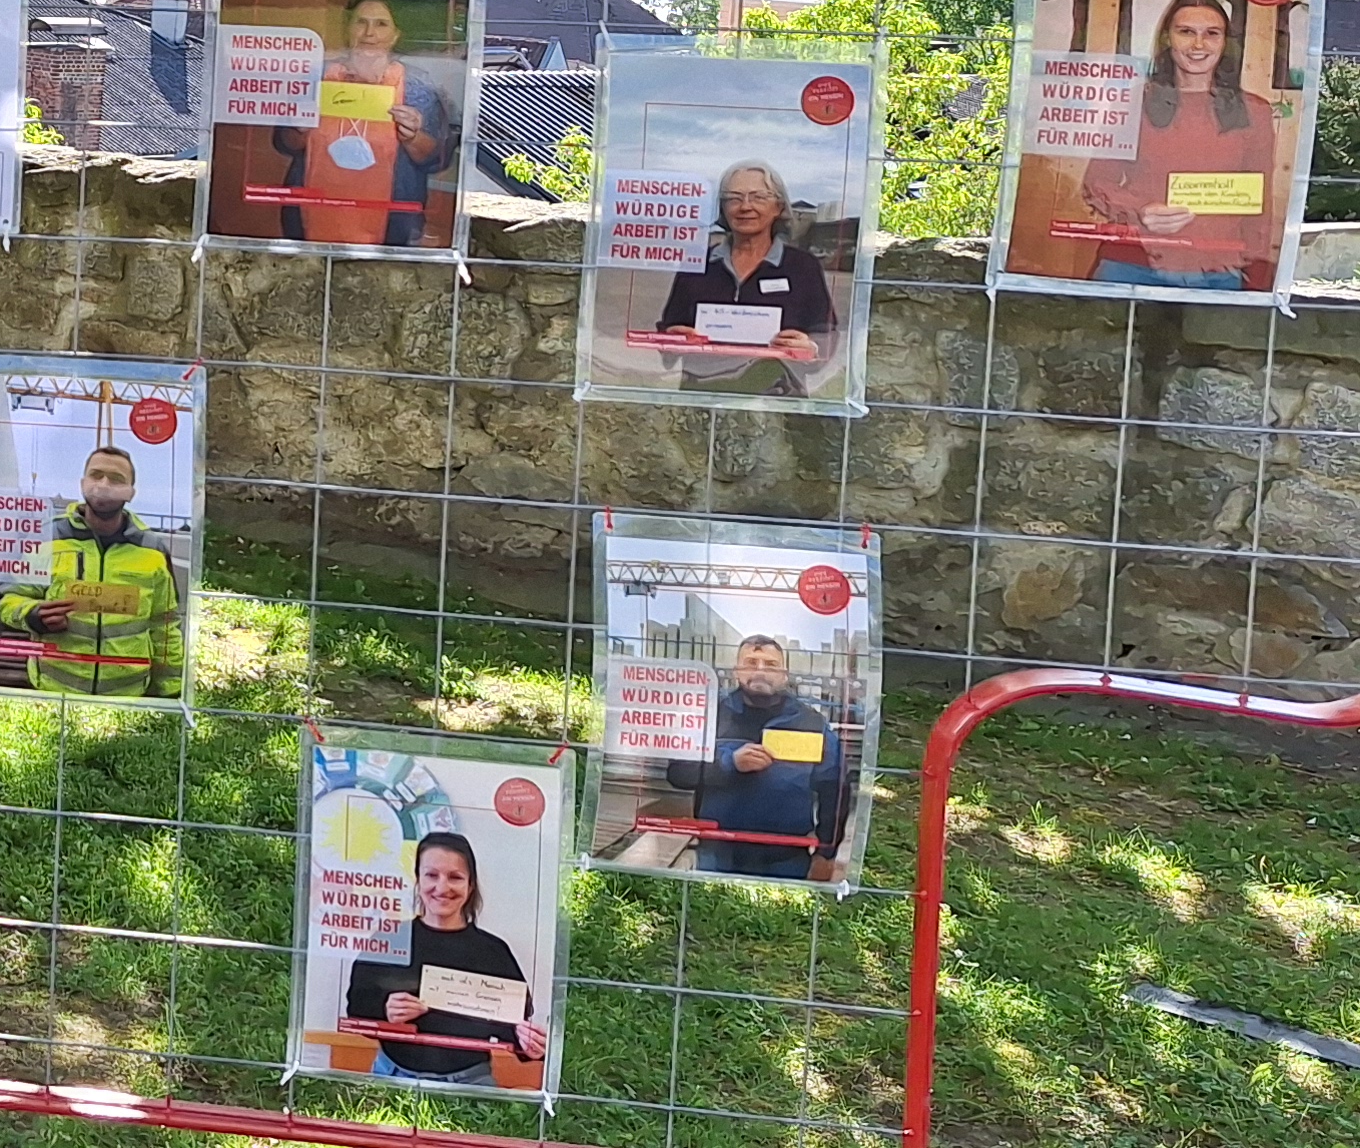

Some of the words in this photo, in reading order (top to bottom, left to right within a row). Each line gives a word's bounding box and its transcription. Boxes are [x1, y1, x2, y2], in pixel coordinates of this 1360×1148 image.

[232, 35, 317, 51] MENSCHEN-
[231, 56, 310, 73] WÜRDIGE
[1045, 61, 1138, 78] MENSCHEN-
[229, 79, 281, 94] ARBEIT
[287, 81, 310, 95] IST
[1042, 82, 1131, 102] WÜRDIGE
[228, 98, 255, 114] FÜR
[260, 101, 297, 116] MICH
[1039, 107, 1097, 123] ARBEIT
[1103, 110, 1128, 125] IST
[1037, 129, 1068, 145] FÜR
[1073, 133, 1114, 148] MICH
[617, 179, 706, 196] MENSCHEN-
[615, 199, 699, 219] WÜRDIGE
[613, 224, 667, 239] ARBEIT
[673, 226, 698, 240] IST
[611, 242, 640, 259] FÜR
[645, 246, 683, 261] MICH
[20, 539, 42, 553] IST
[623, 665, 710, 684] MENSCHEN-
[622, 686, 706, 707] WÜRDIGE
[621, 710, 675, 726] ARBEIT
[681, 713, 706, 729] IST
[620, 730, 648, 747] FÜR
[653, 733, 691, 749] MICH
[323, 870, 407, 891] MENSCHEN-
[322, 890, 401, 911] WÜRDIGE
[321, 912, 373, 930] ARBEIT
[378, 917, 401, 932] IST
[321, 933, 348, 949] FÜR
[352, 937, 389, 954] MICH
